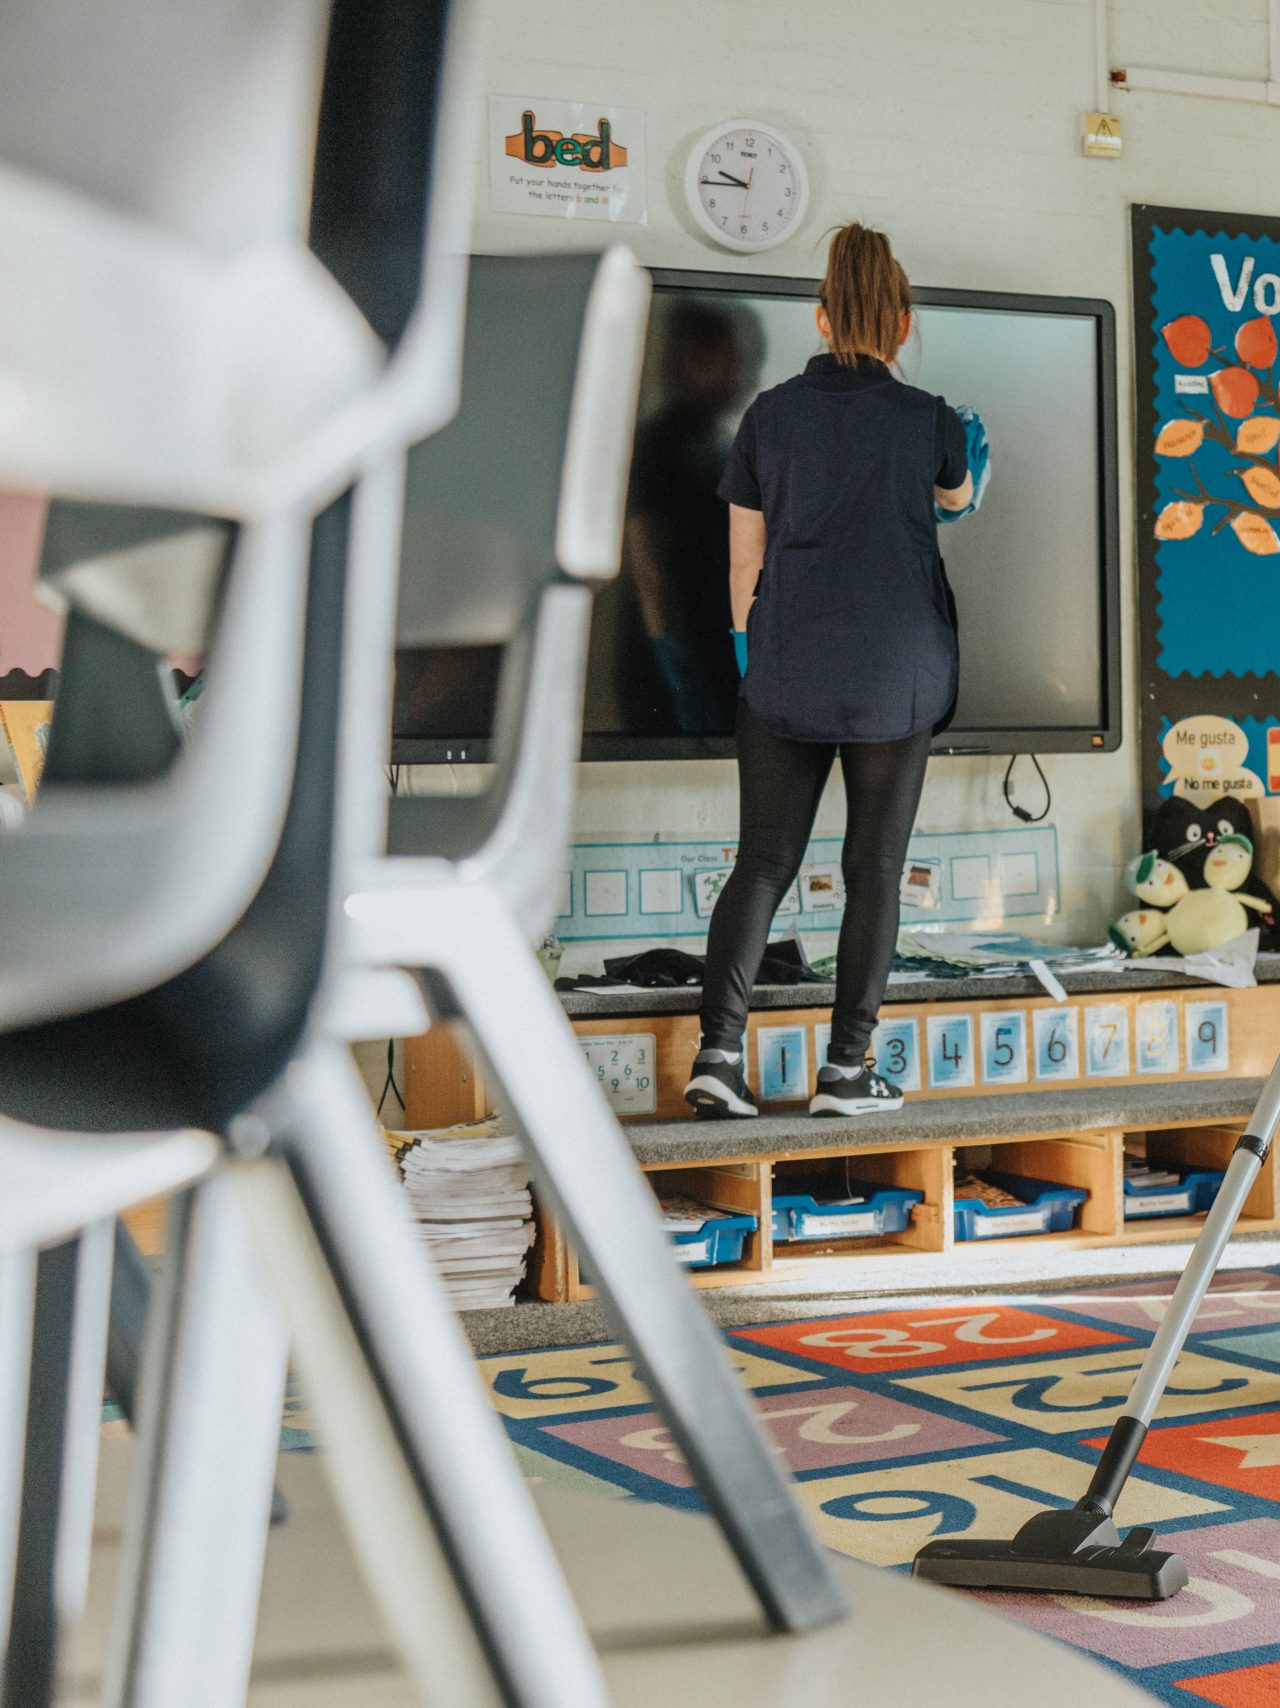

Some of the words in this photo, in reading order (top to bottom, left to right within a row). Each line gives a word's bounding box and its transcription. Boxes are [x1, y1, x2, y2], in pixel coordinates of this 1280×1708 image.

[522, 113, 611, 170] bed
[725, 142, 735, 151] 11
[744, 138, 756, 148] 12
[768, 148, 773, 157] 1
[710, 154, 721, 164] 10
[779, 164, 786, 174] 2
[526, 178, 545, 187] your
[547, 178, 571, 189] hands
[574, 182, 610, 192] together
[528, 191, 542, 199] the
[584, 196, 599, 204] and
[784, 187, 792, 197] 3
[709, 198, 716, 208] 8
[722, 216, 728, 226] 7
[762, 222, 769, 231] 5
[740, 224, 748, 234] 6
[1176, 730, 1196, 745] Me
[1200, 731, 1236, 748] gusta
[1184, 778, 1200, 790] No
[1202, 780, 1220, 790] me
[1222, 778, 1253, 792] gusta
[1098, 1023, 1117, 1060] 7
[1146, 1019, 1168, 1057] 8
[1198, 1021, 1217, 1054] 9
[942, 1033, 962, 1068] 4
[994, 1027, 1014, 1066] 5
[1047, 1028, 1067, 1063] 6
[611, 1050, 618, 1062] 2
[638, 1049, 646, 1060] 3
[886, 1038, 907, 1074] 3
[598, 1065, 605, 1077] 5
[624, 1064, 632, 1076] 6
[781, 1046, 787, 1084] 1
[611, 1078, 619, 1090] 9
[635, 1077, 650, 1089] 10
[799, 1311, 1058, 1358] 28
[820, 1473, 1078, 1536] 16
